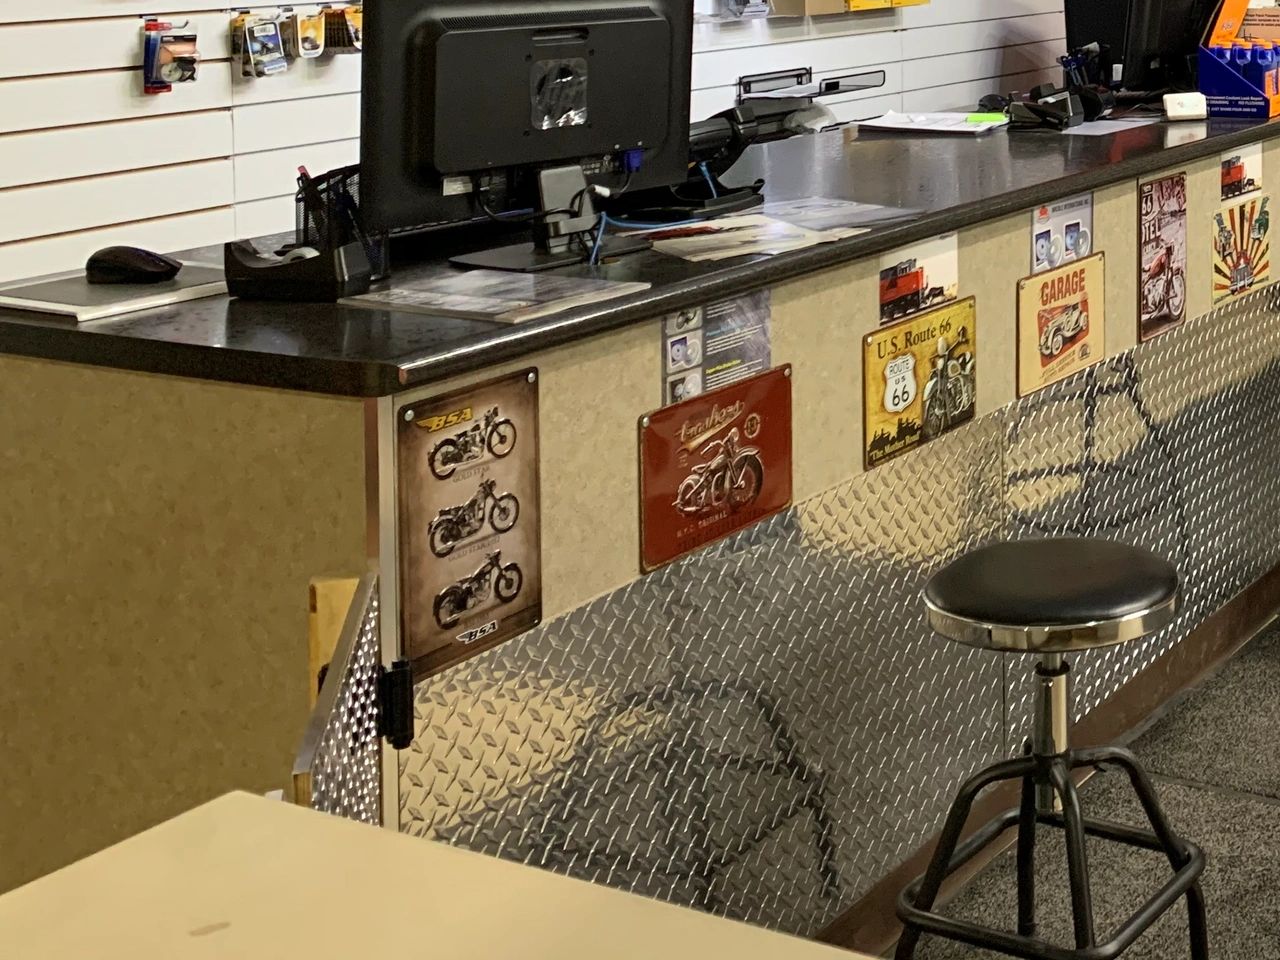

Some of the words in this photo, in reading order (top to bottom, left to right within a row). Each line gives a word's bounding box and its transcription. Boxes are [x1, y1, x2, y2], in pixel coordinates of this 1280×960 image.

[1040, 268, 1085, 306] GARAGE
[878, 335, 901, 359] U.S.
[904, 326, 936, 350] Route
[939, 316, 952, 335] 66
[889, 359, 910, 374] ROUTE
[892, 387, 910, 407] 66
[430, 406, 474, 432] BSA
[467, 620, 498, 642] BSA
